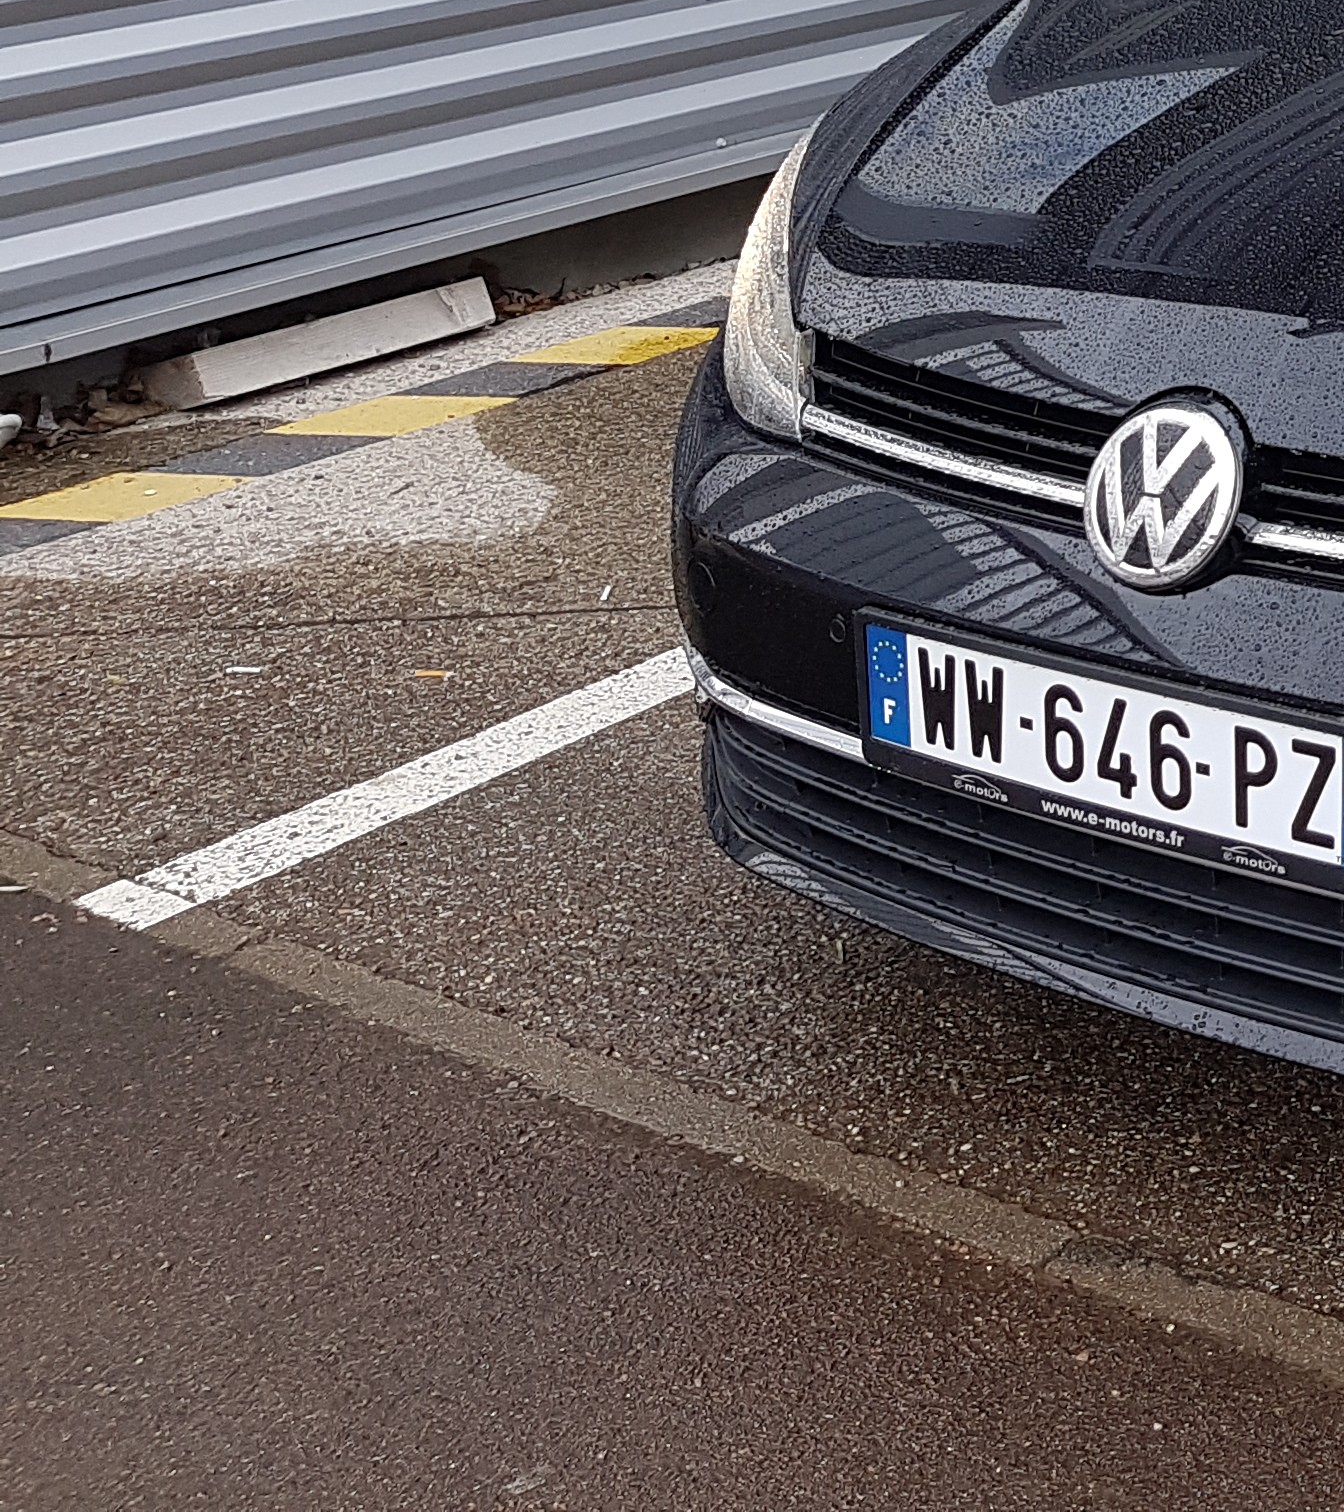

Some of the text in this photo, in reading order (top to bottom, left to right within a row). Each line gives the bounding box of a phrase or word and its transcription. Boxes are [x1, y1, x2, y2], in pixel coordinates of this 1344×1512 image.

[883, 697, 897, 725] F
[917, 646, 1338, 851] WW-646-PZ
[1041, 799, 1185, 848] www.e-motors.fr
